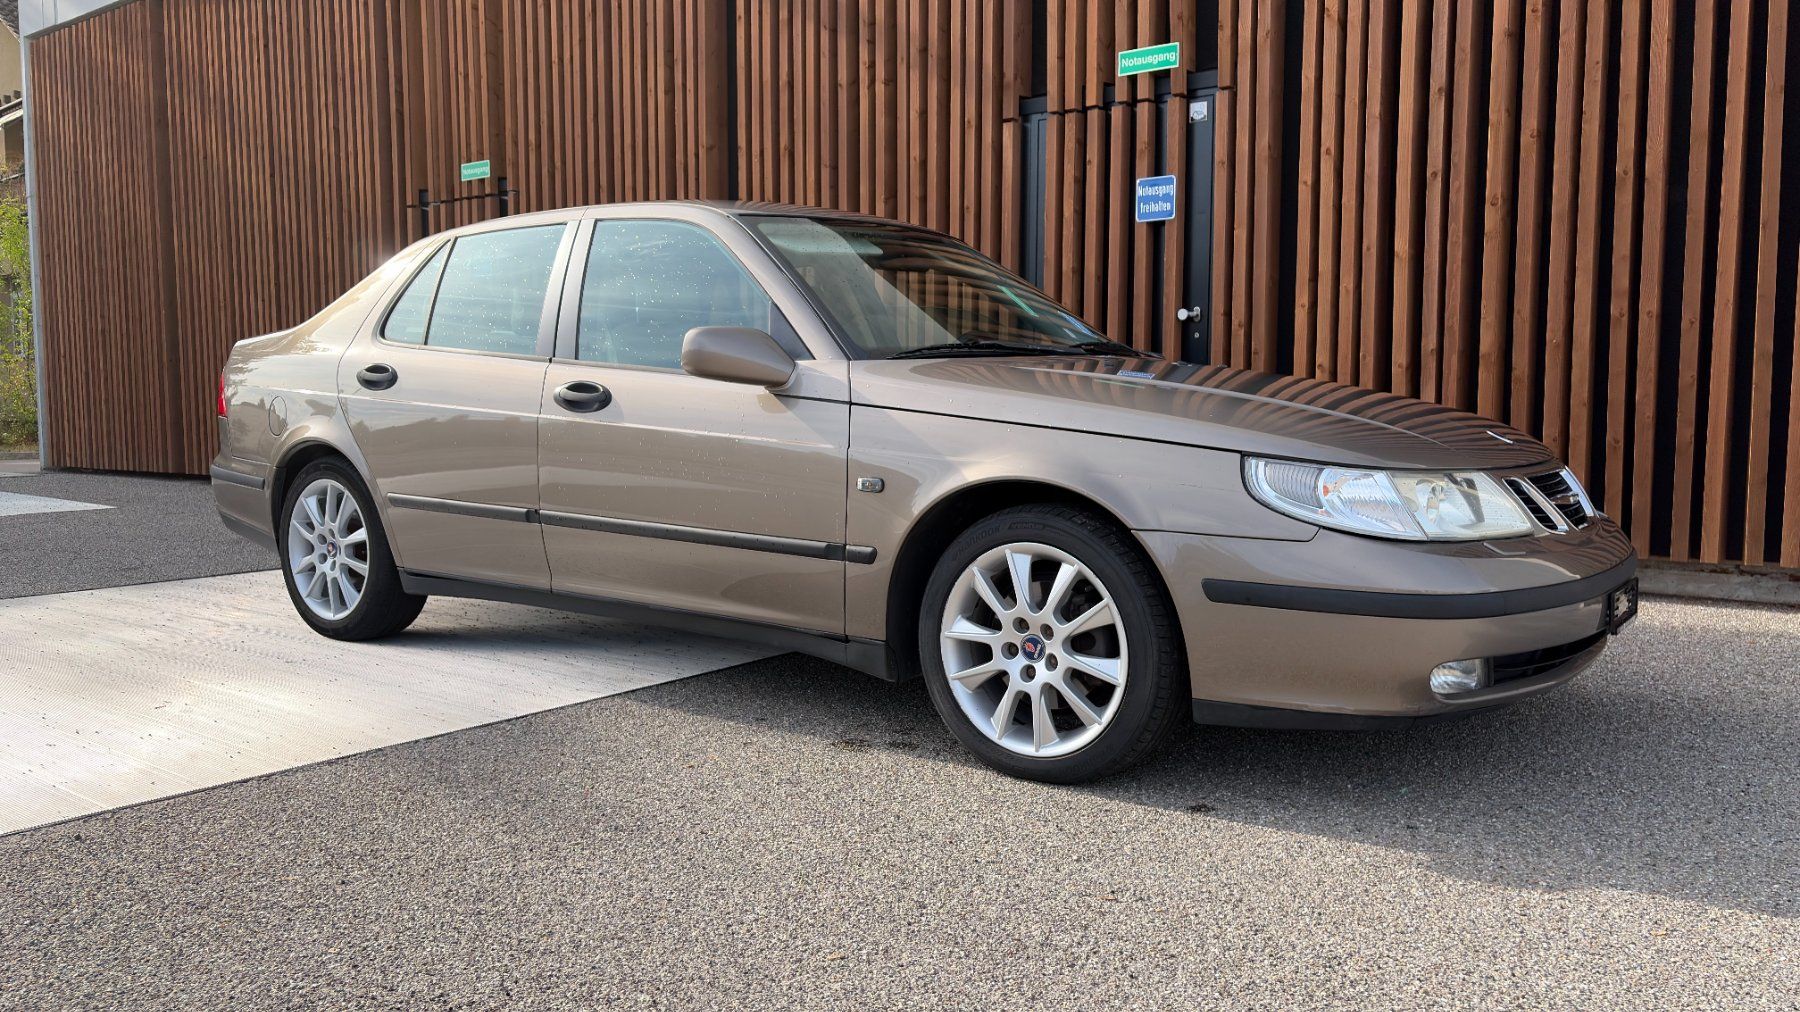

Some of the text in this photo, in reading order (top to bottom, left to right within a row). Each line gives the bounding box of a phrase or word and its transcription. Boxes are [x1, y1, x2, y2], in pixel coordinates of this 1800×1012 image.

[1121, 51, 1176, 68] Notausgang
[1138, 184, 1174, 197] Notausgang
[1140, 200, 1171, 214] freihalten
